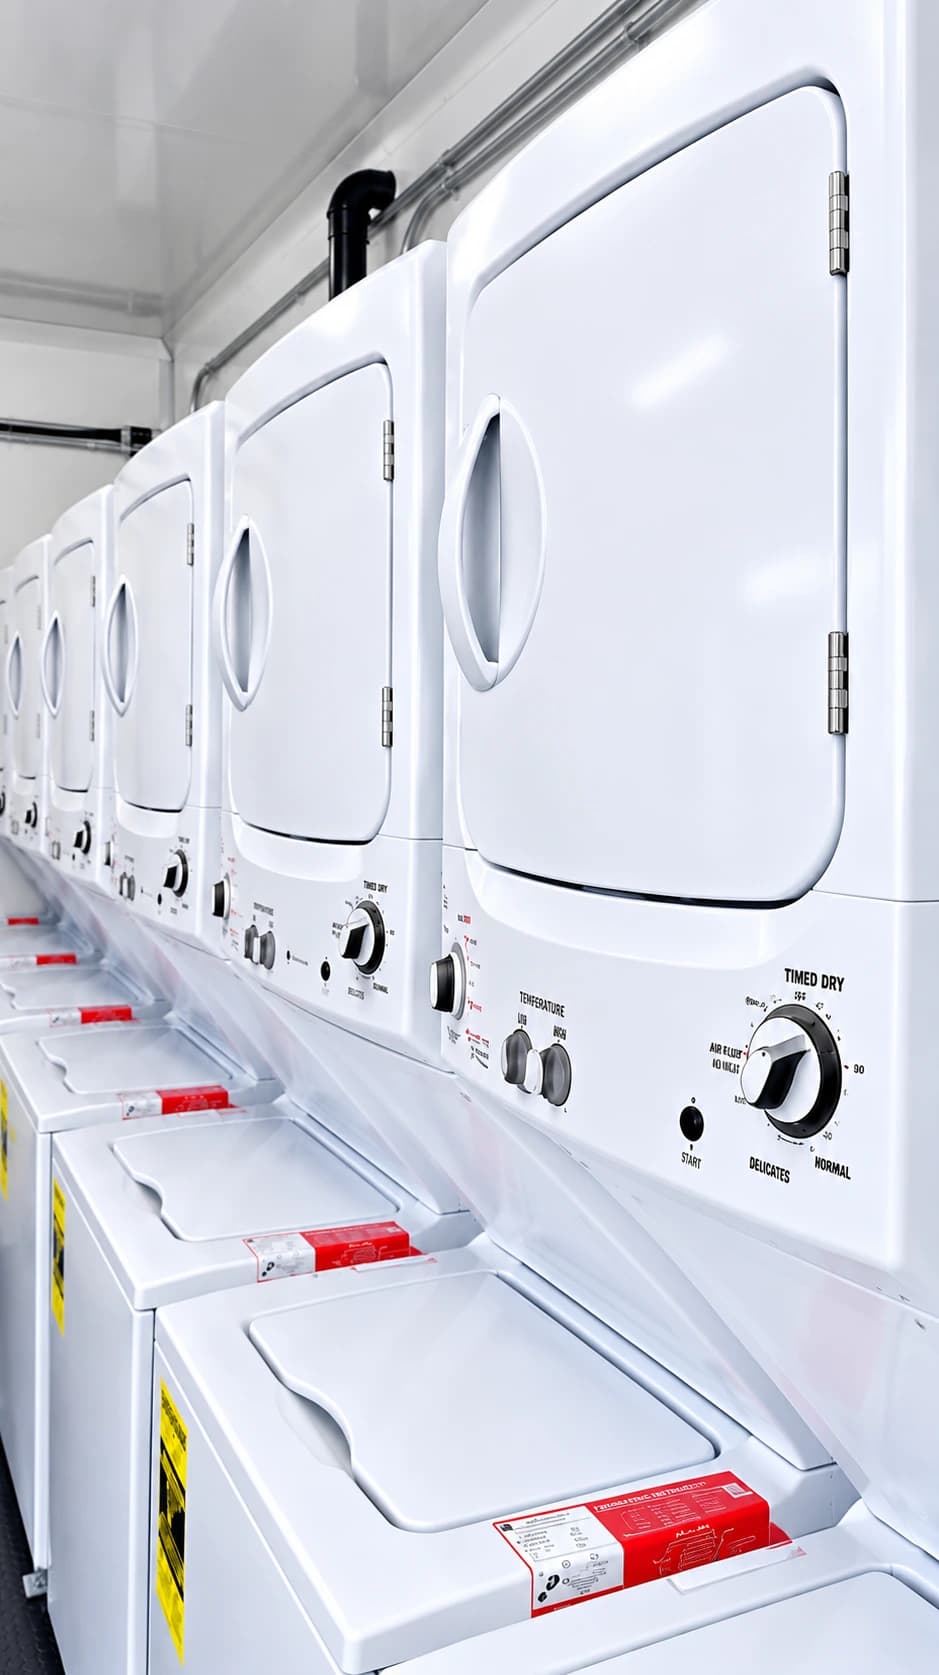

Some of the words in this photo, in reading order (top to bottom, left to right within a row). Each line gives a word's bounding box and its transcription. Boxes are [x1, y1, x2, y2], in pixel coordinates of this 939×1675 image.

[784, 968, 818, 987] TIMED
[821, 974, 845, 992] DRY
[681, 1151, 702, 1170] START
[749, 1156, 791, 1183] DELICATES
